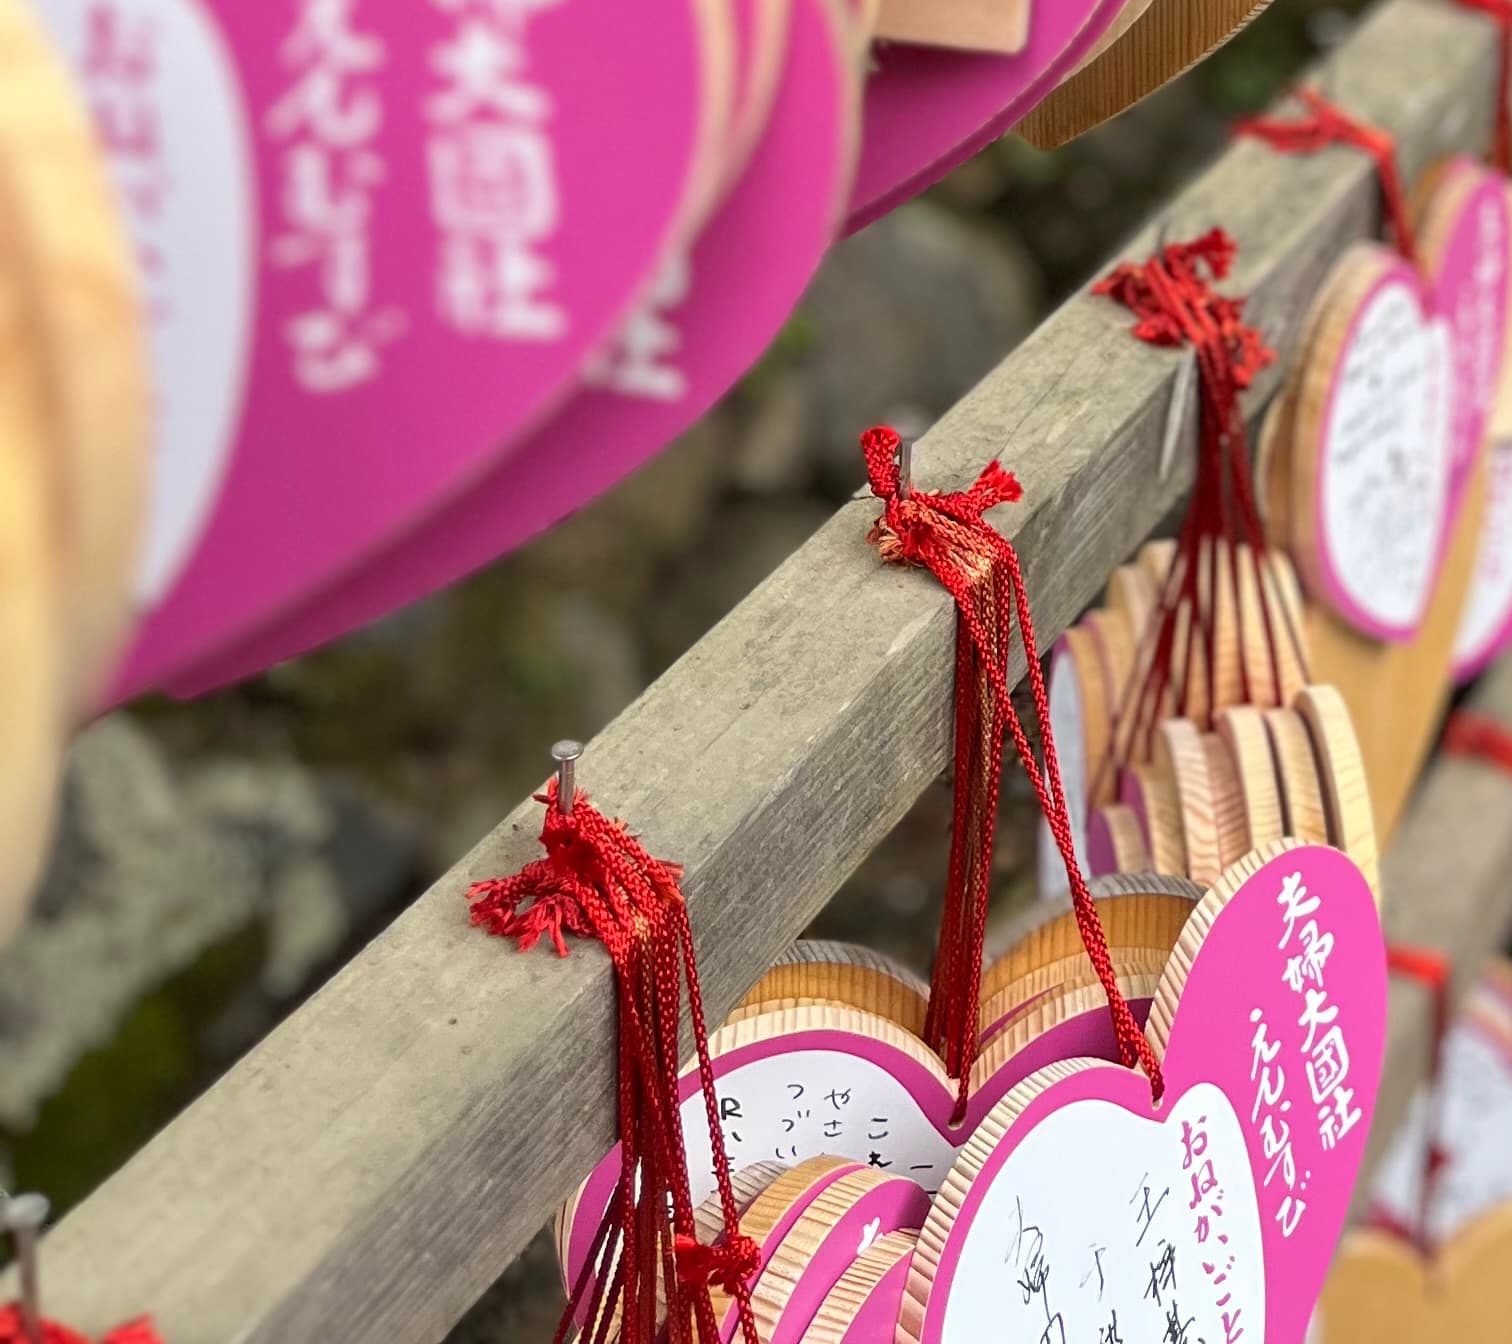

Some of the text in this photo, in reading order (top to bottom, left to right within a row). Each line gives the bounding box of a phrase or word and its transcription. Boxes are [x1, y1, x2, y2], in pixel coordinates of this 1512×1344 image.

[1249, 1007, 1312, 1238] えんむすび
[1277, 870, 1362, 1152] 夫婦大國社
